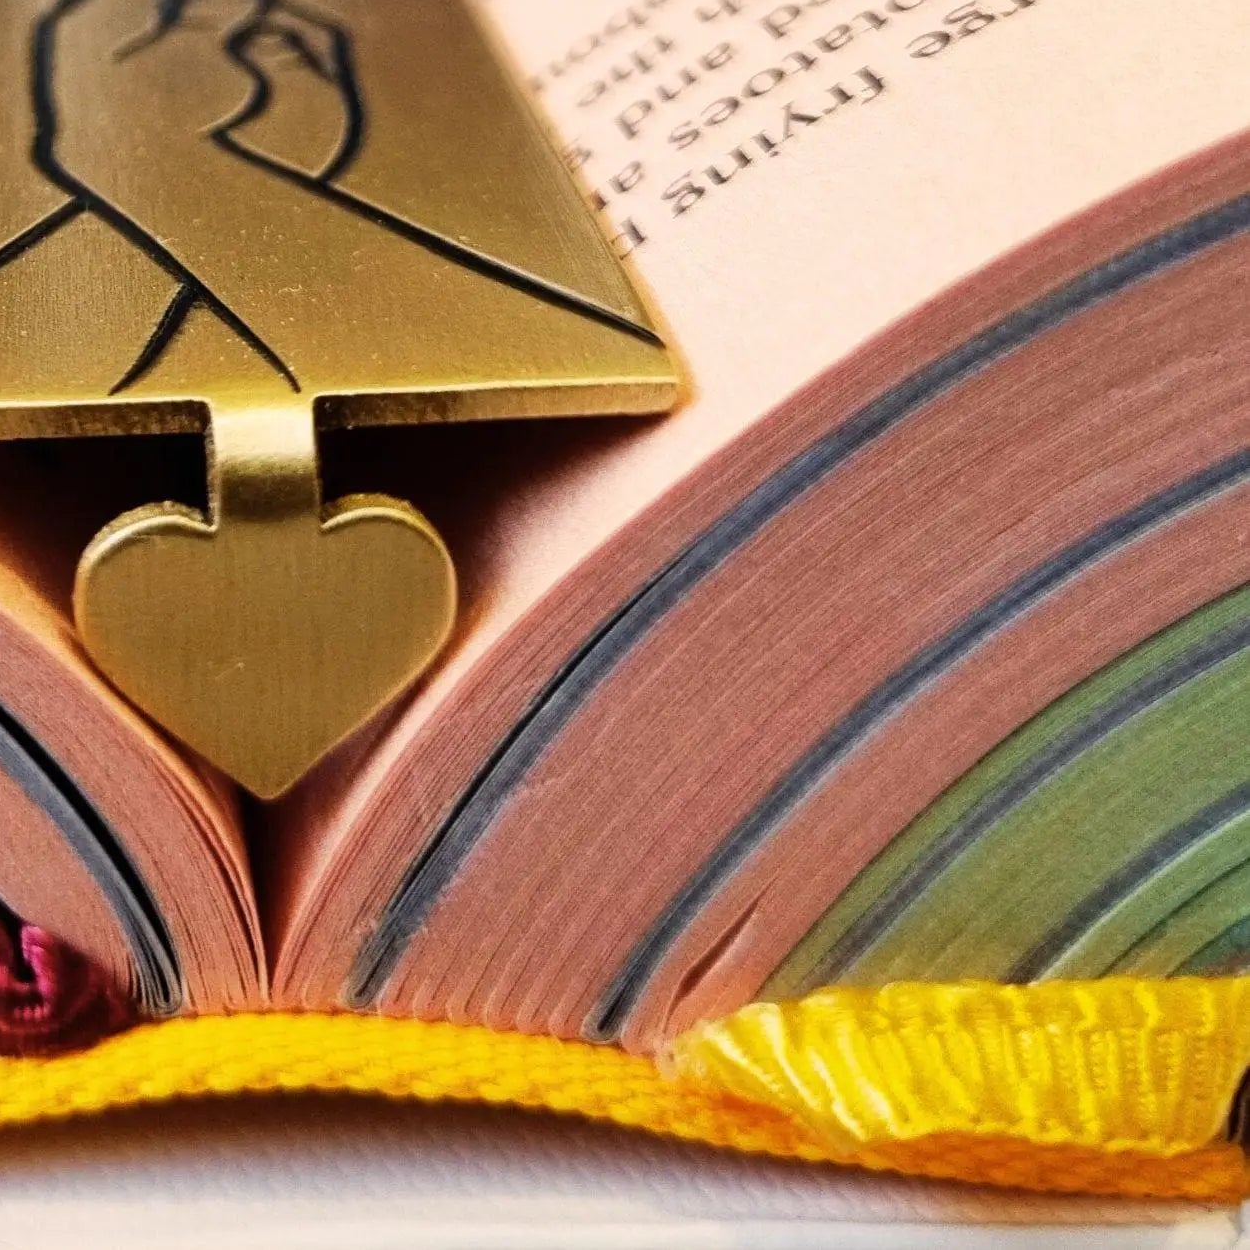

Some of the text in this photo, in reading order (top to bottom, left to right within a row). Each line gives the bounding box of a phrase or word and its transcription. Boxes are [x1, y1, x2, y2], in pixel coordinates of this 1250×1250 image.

[576, 35, 674, 108] the
[614, 42, 734, 141] and
[660, 67, 884, 217] frying
